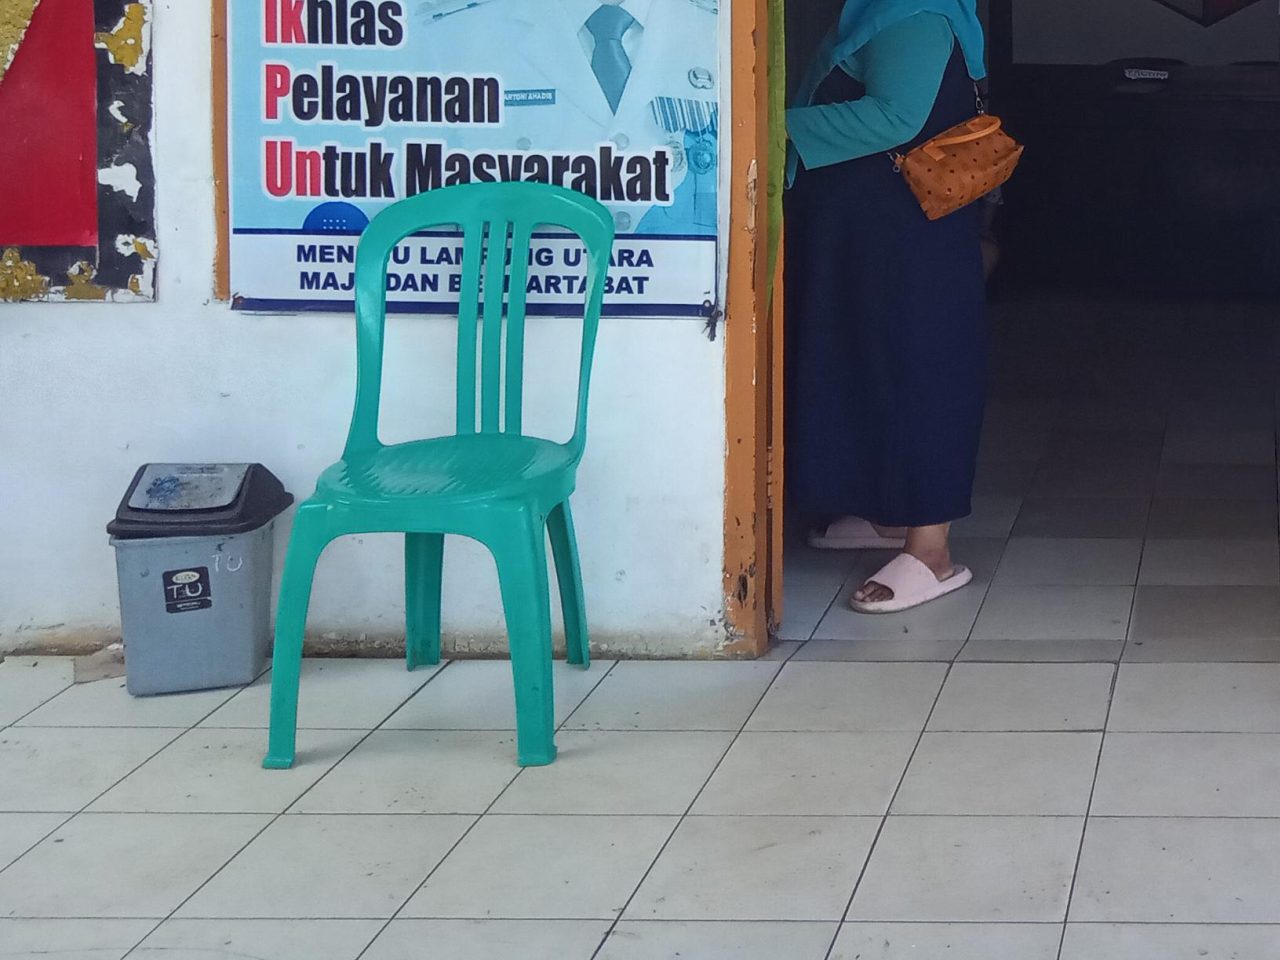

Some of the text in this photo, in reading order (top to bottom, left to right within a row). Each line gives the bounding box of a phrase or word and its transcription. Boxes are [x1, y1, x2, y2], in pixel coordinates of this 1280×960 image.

[264, 64, 500, 128] Pelayanan
[264, 140, 395, 199] Untuk
[297, 244, 411, 265] MENU
[563, 248, 654, 268] URA
[300, 271, 356, 291] MAJ
[386, 273, 439, 292] DAN
[211, 554, 243, 572] TU
[167, 583, 203, 599] TU
